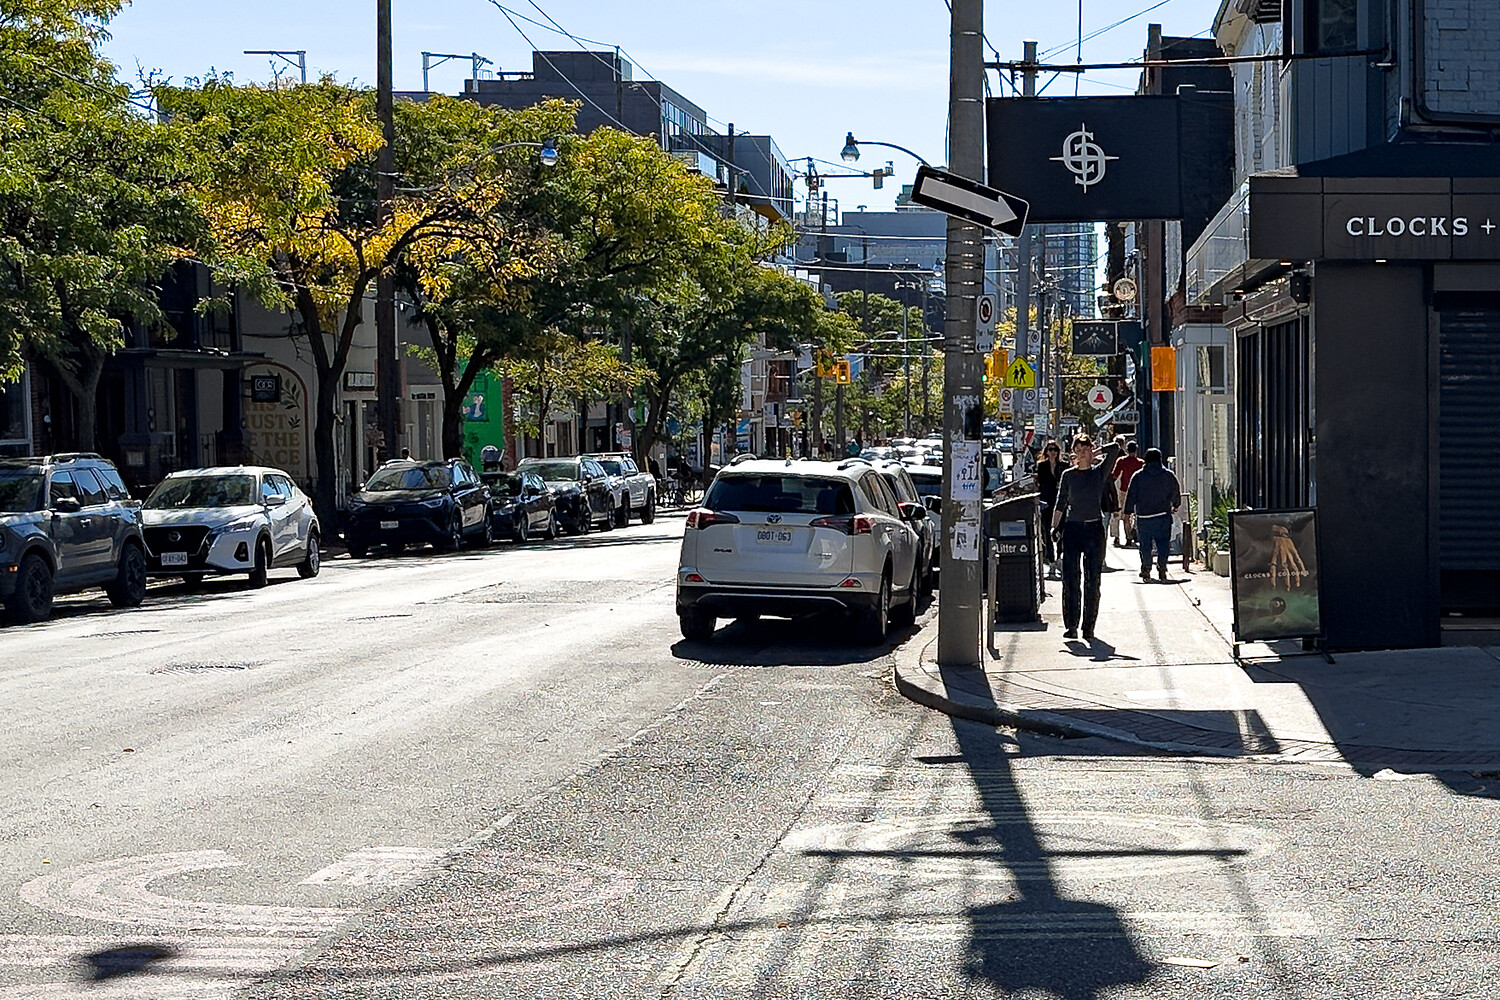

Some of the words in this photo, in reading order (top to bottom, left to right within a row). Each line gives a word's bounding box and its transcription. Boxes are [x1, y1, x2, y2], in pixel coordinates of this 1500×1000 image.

[1346, 217, 1469, 237] CLOCKS
[246, 414, 286, 429] UST
[262, 432, 300, 447] THE
[264, 450, 300, 465] ACE
